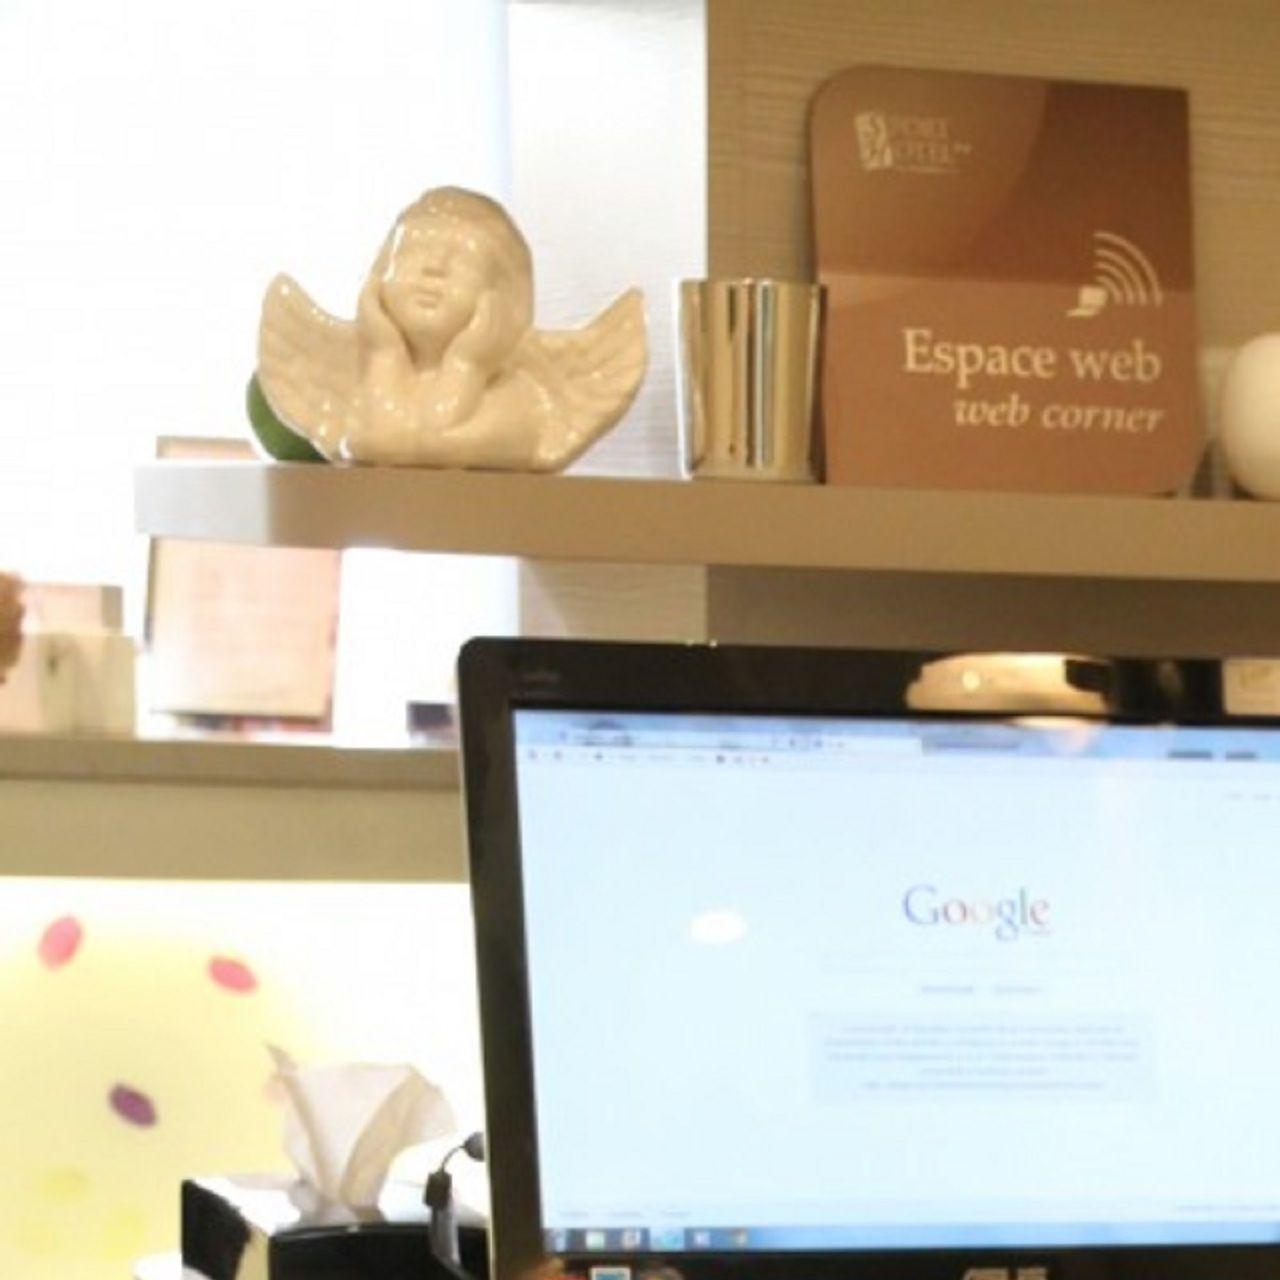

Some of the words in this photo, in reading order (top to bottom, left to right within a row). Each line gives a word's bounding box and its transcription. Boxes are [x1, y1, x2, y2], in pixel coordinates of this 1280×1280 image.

[902, 328, 1058, 389] Espace
[1069, 338, 1162, 383] web
[953, 393, 1031, 429] web
[1041, 402, 1168, 433] corner
[901, 883, 1051, 942] Google
